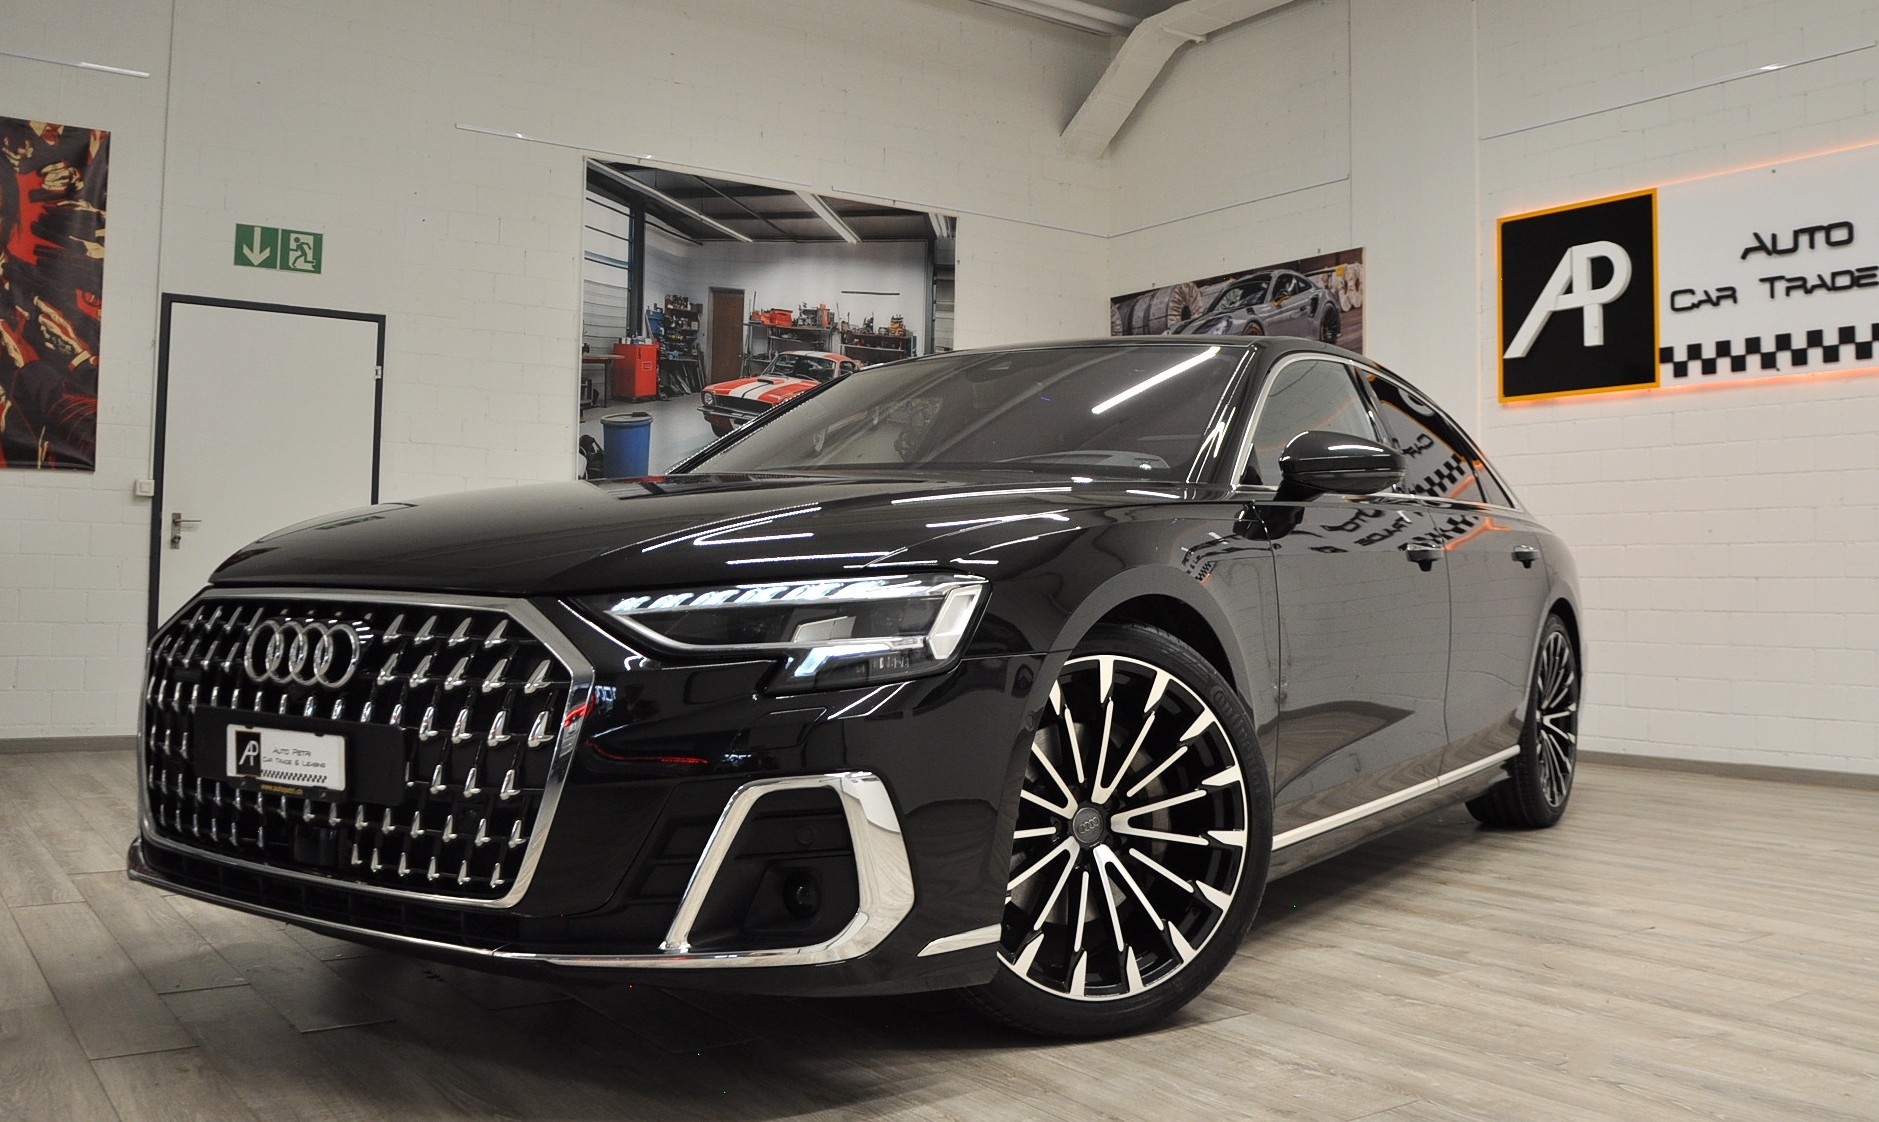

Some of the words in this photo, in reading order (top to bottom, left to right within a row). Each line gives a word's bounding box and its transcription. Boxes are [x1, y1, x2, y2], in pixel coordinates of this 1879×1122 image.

[1740, 221, 1854, 260] AUTO
[1670, 286, 1737, 312] CAR
[1759, 265, 1879, 299] TRADE
